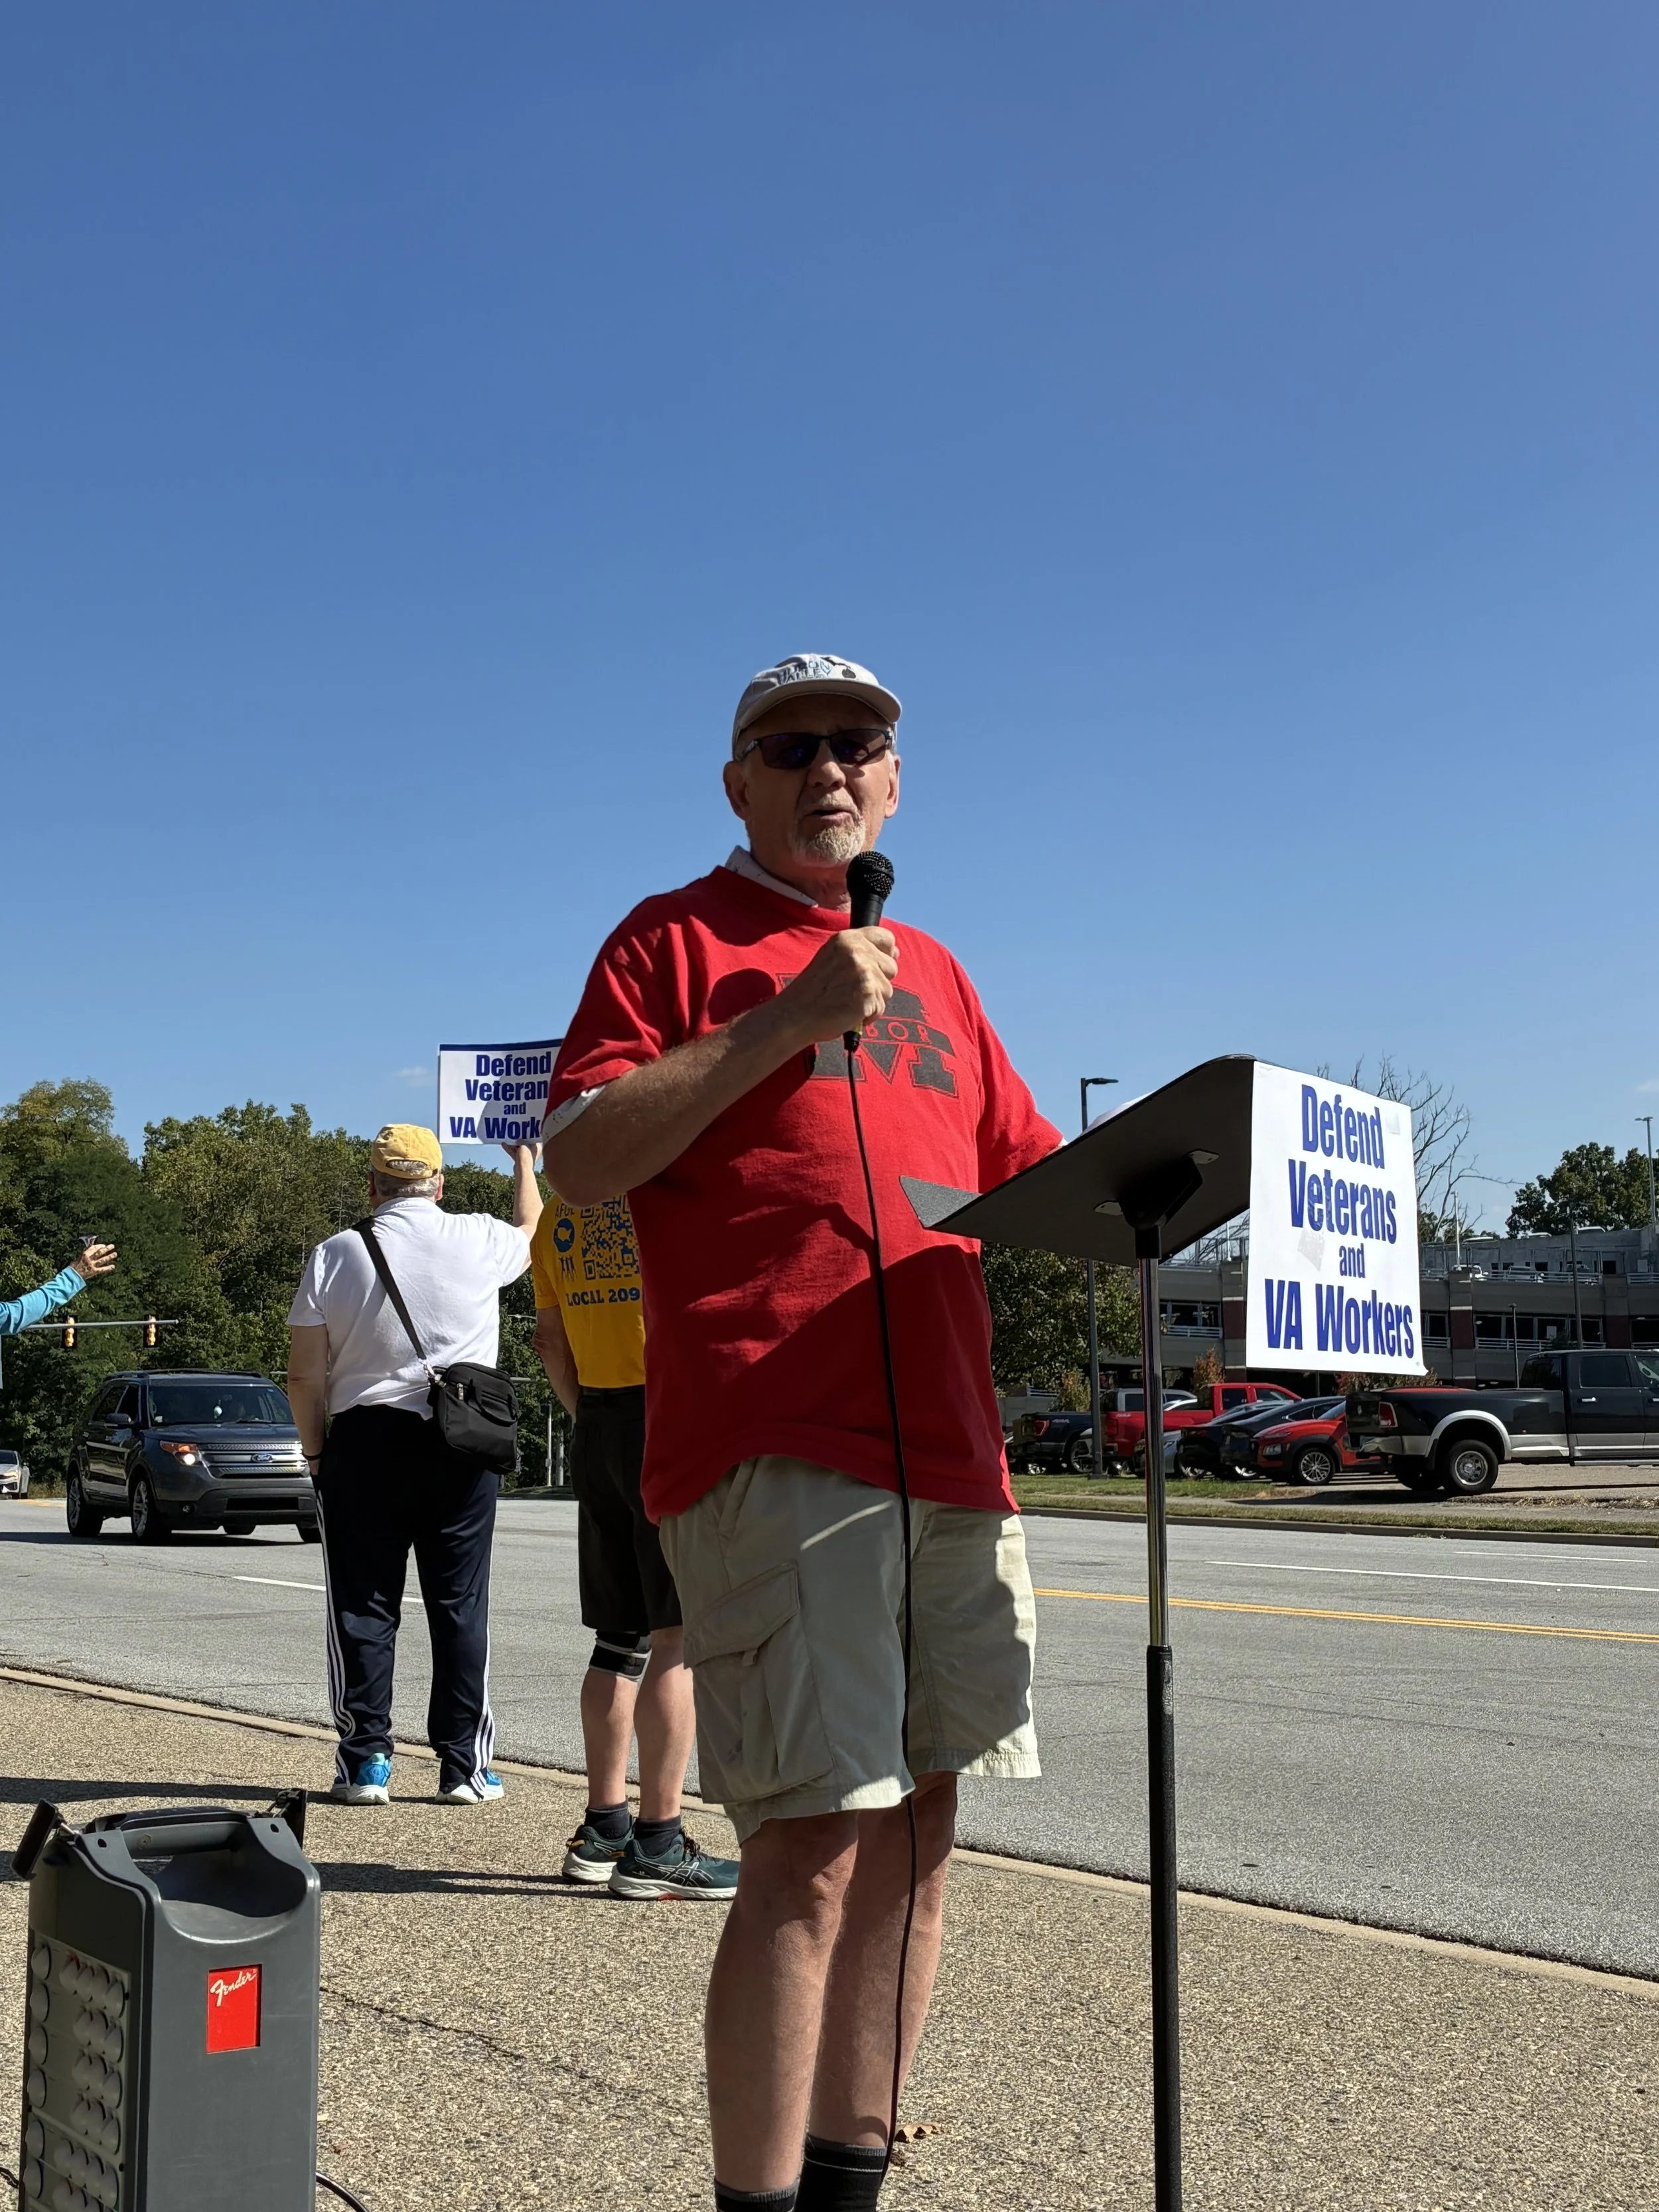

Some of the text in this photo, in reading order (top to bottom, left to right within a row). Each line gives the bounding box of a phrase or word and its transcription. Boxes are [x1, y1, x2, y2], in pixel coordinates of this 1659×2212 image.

[476, 1051, 551, 1076] Defend
[465, 1079, 548, 1101] Veteran
[504, 1102, 526, 1115] and
[450, 1116, 541, 1140] VA Work
[1301, 1084, 1385, 1169] Defend
[1288, 1159, 1397, 1244] Veterans
[1339, 1243, 1366, 1279] and
[566, 1290, 605, 1306] LOCAL
[1265, 1278, 1414, 1359] VA Workers
[210, 1971, 257, 2007] Fender
